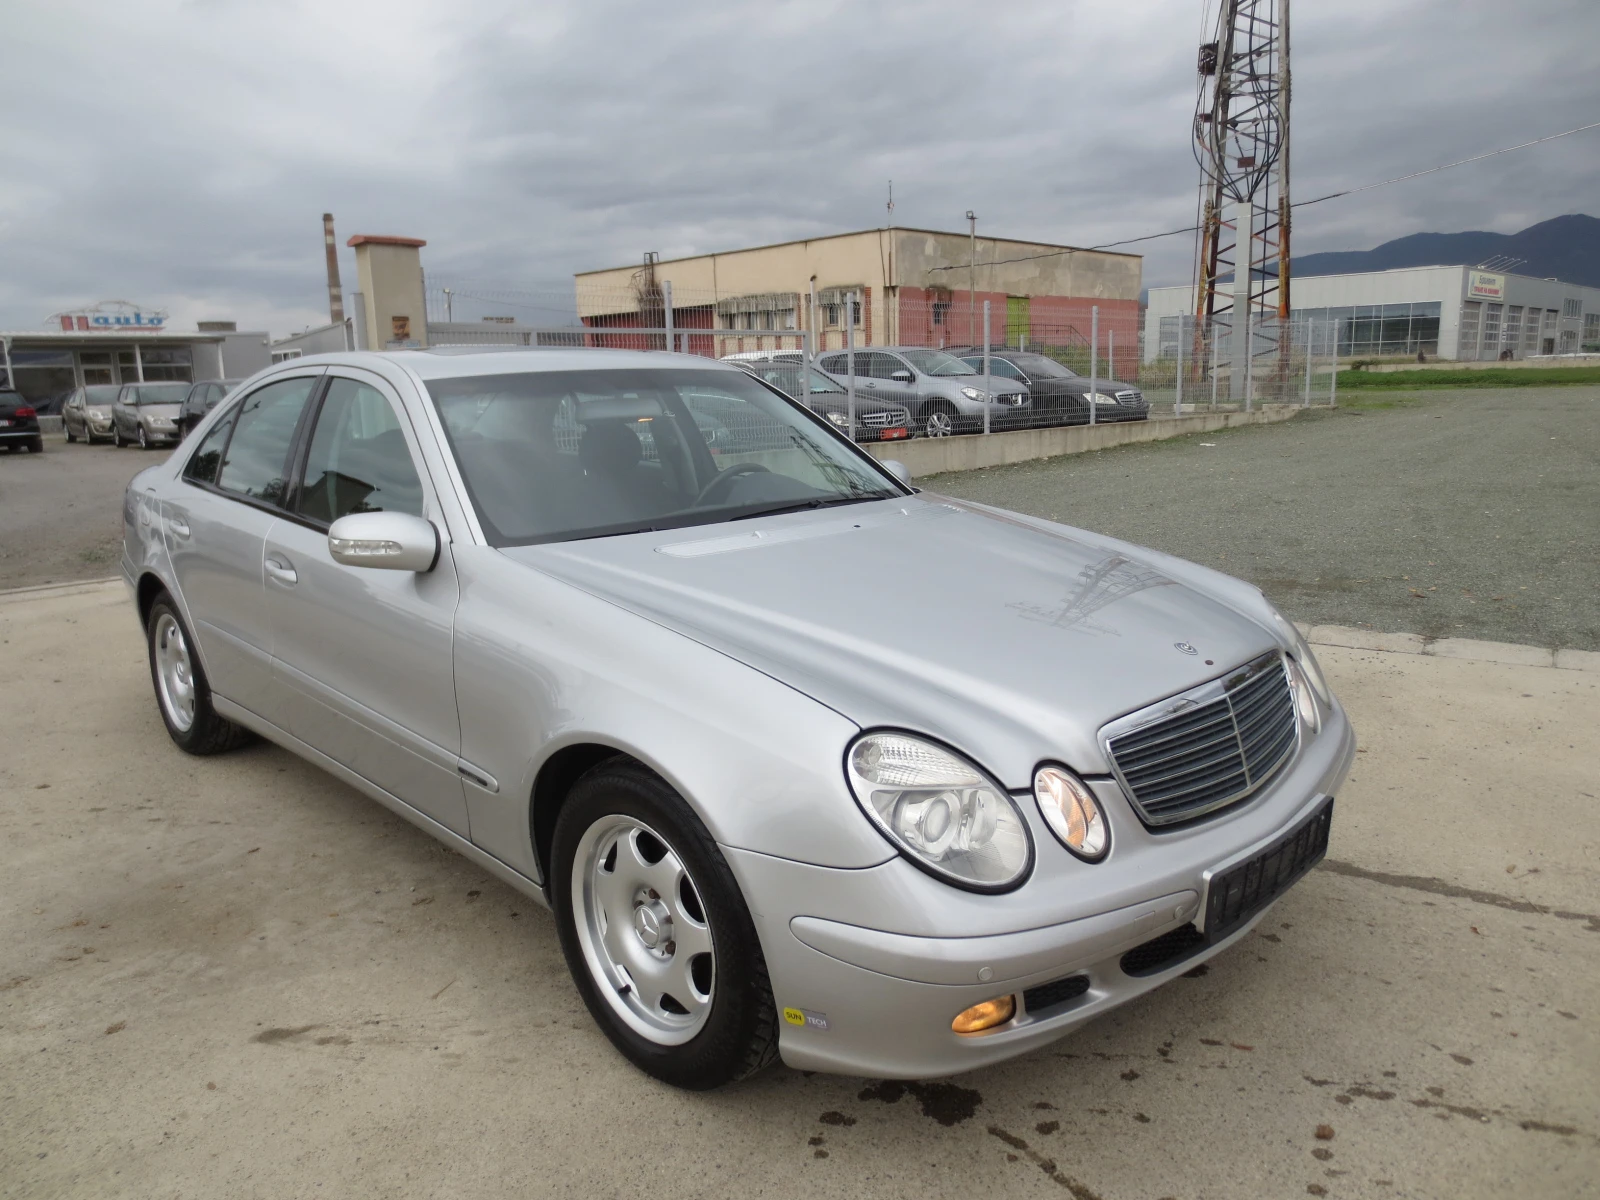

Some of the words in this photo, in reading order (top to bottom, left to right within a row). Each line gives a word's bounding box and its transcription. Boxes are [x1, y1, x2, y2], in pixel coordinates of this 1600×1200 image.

[94, 312, 163, 326] auto
[786, 1012, 802, 1021] SUN
[806, 1016, 827, 1027] TECH
